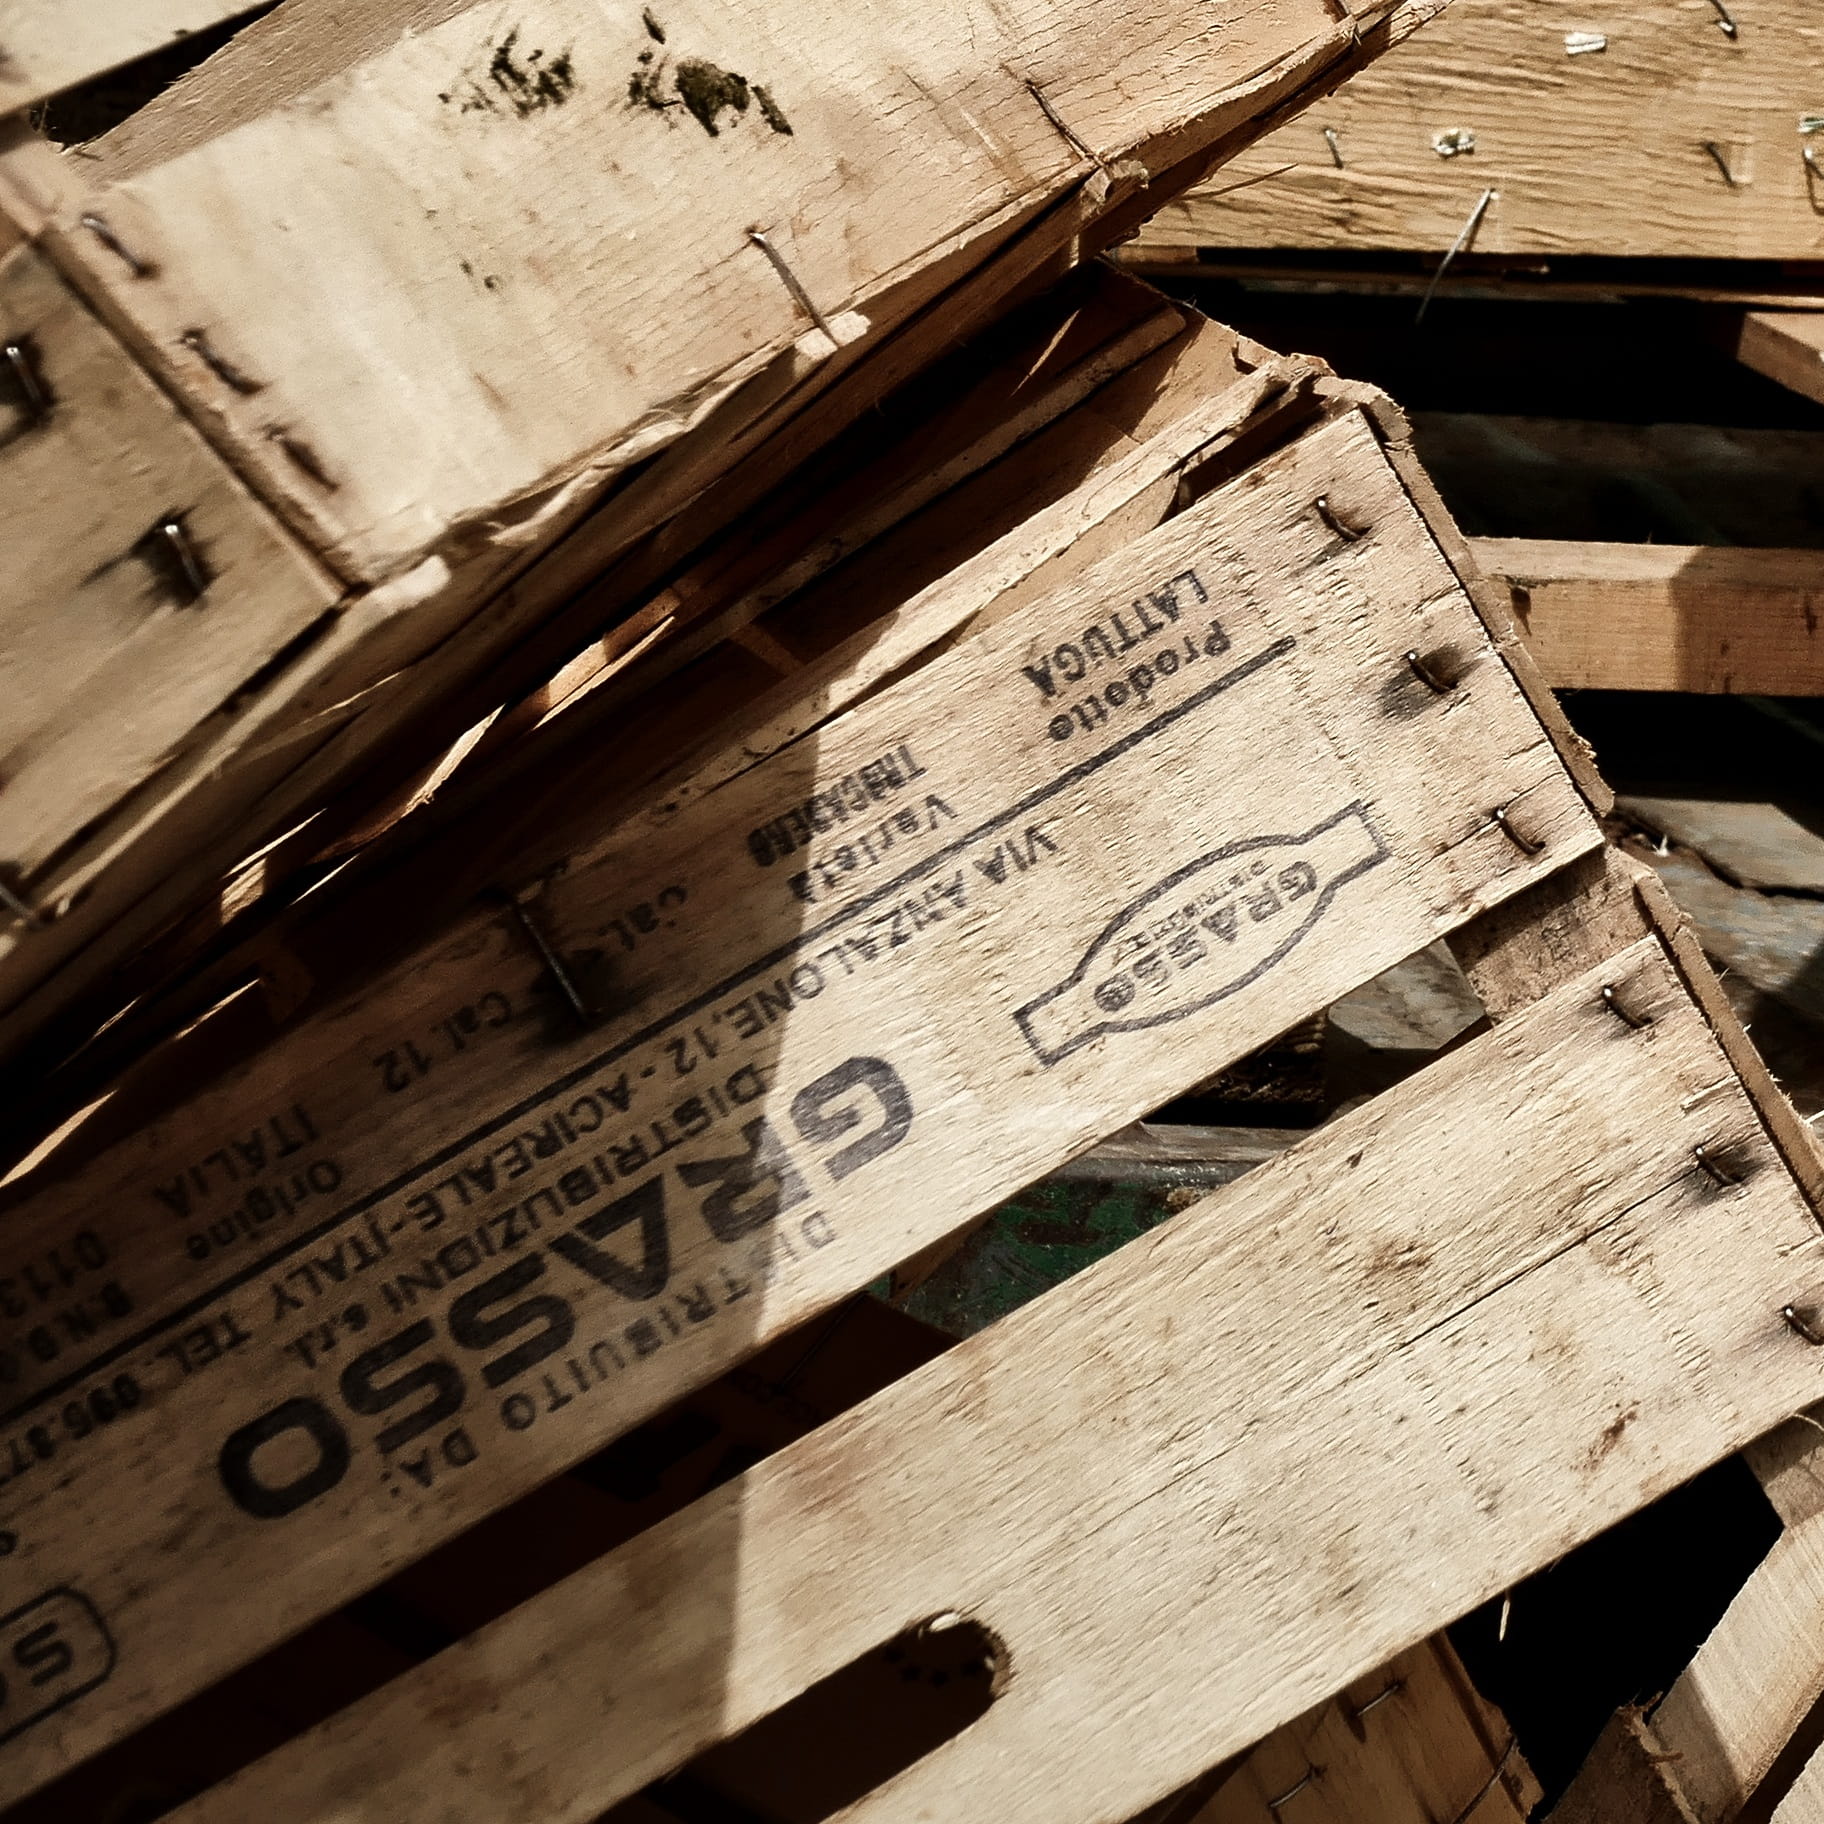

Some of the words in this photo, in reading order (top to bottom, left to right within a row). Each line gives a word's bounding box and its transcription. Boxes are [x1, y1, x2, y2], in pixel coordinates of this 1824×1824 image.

[1020, 566, 1212, 704] LATTUGA
[970, 819, 1059, 892] VIA
[1084, 855, 1326, 1018] GRASSO
[369, 1032, 437, 1094] 12
[428, 984, 517, 1058] Cal.
[150, 1101, 321, 1225] ITALIA
[176, 1144, 349, 1271] Origine
[376, 1059, 770, 1317] DISTRIBUZIONI
[143, 1305, 252, 1391] TEL.
[215, 1053, 914, 1520] GRASSO
[491, 1207, 840, 1438] DISTRIBUITO
[377, 1425, 480, 1507] DA:
